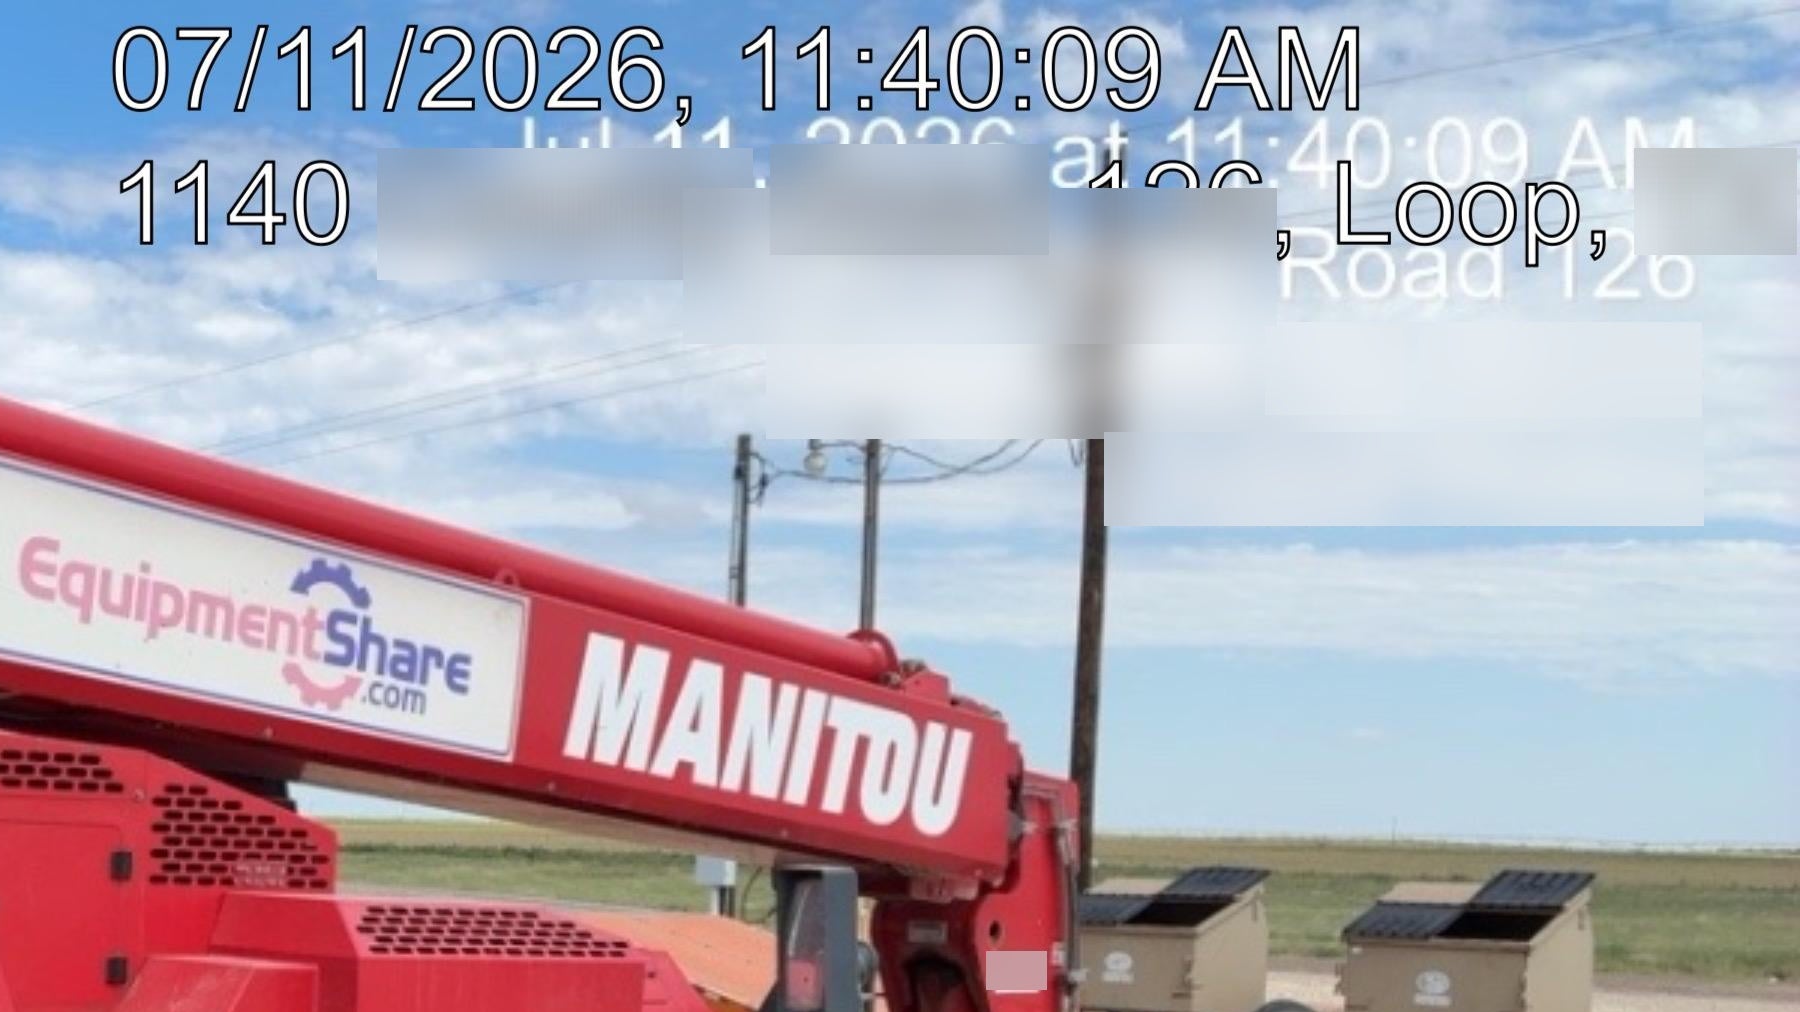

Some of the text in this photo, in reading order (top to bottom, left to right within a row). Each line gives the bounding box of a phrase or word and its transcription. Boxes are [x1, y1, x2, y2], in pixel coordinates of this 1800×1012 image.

[18, 535, 472, 695] EquipmentShare
[361, 679, 428, 716] .com
[562, 631, 974, 837] MANITOU
